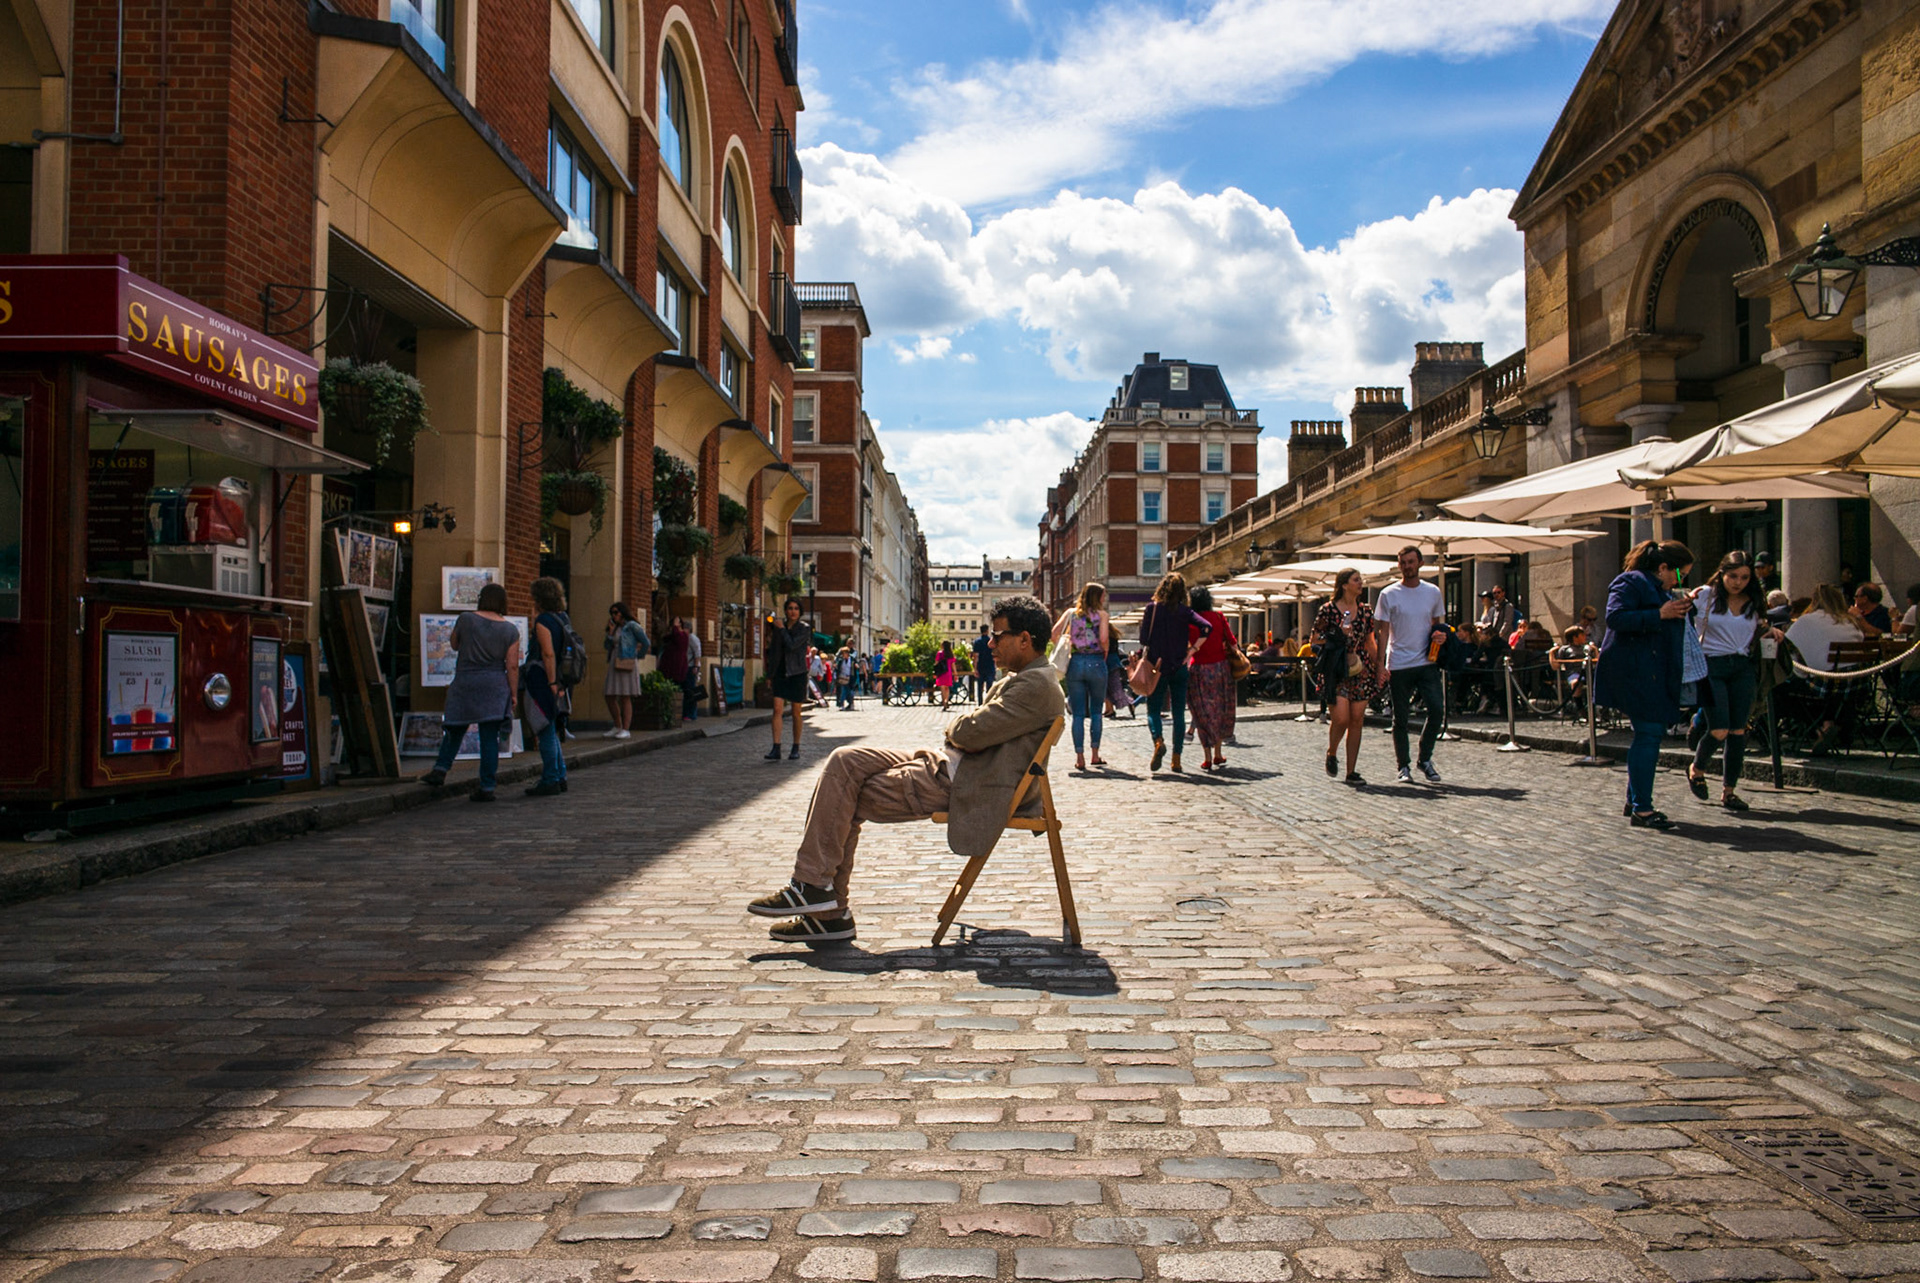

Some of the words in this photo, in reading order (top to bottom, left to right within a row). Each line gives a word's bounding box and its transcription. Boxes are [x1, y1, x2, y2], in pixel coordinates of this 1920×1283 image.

[1672, 202, 1727, 244] GARDEN
[209, 317, 248, 342] HOORAY'S
[128, 301, 307, 406] SAUSAGES
[194, 373, 227, 392] COVENT
[227, 385, 258, 403] GARDEN
[124, 645, 161, 656] SLUSH
[285, 720, 304, 730] CRAFTS
[285, 753, 302, 763] TODAY
